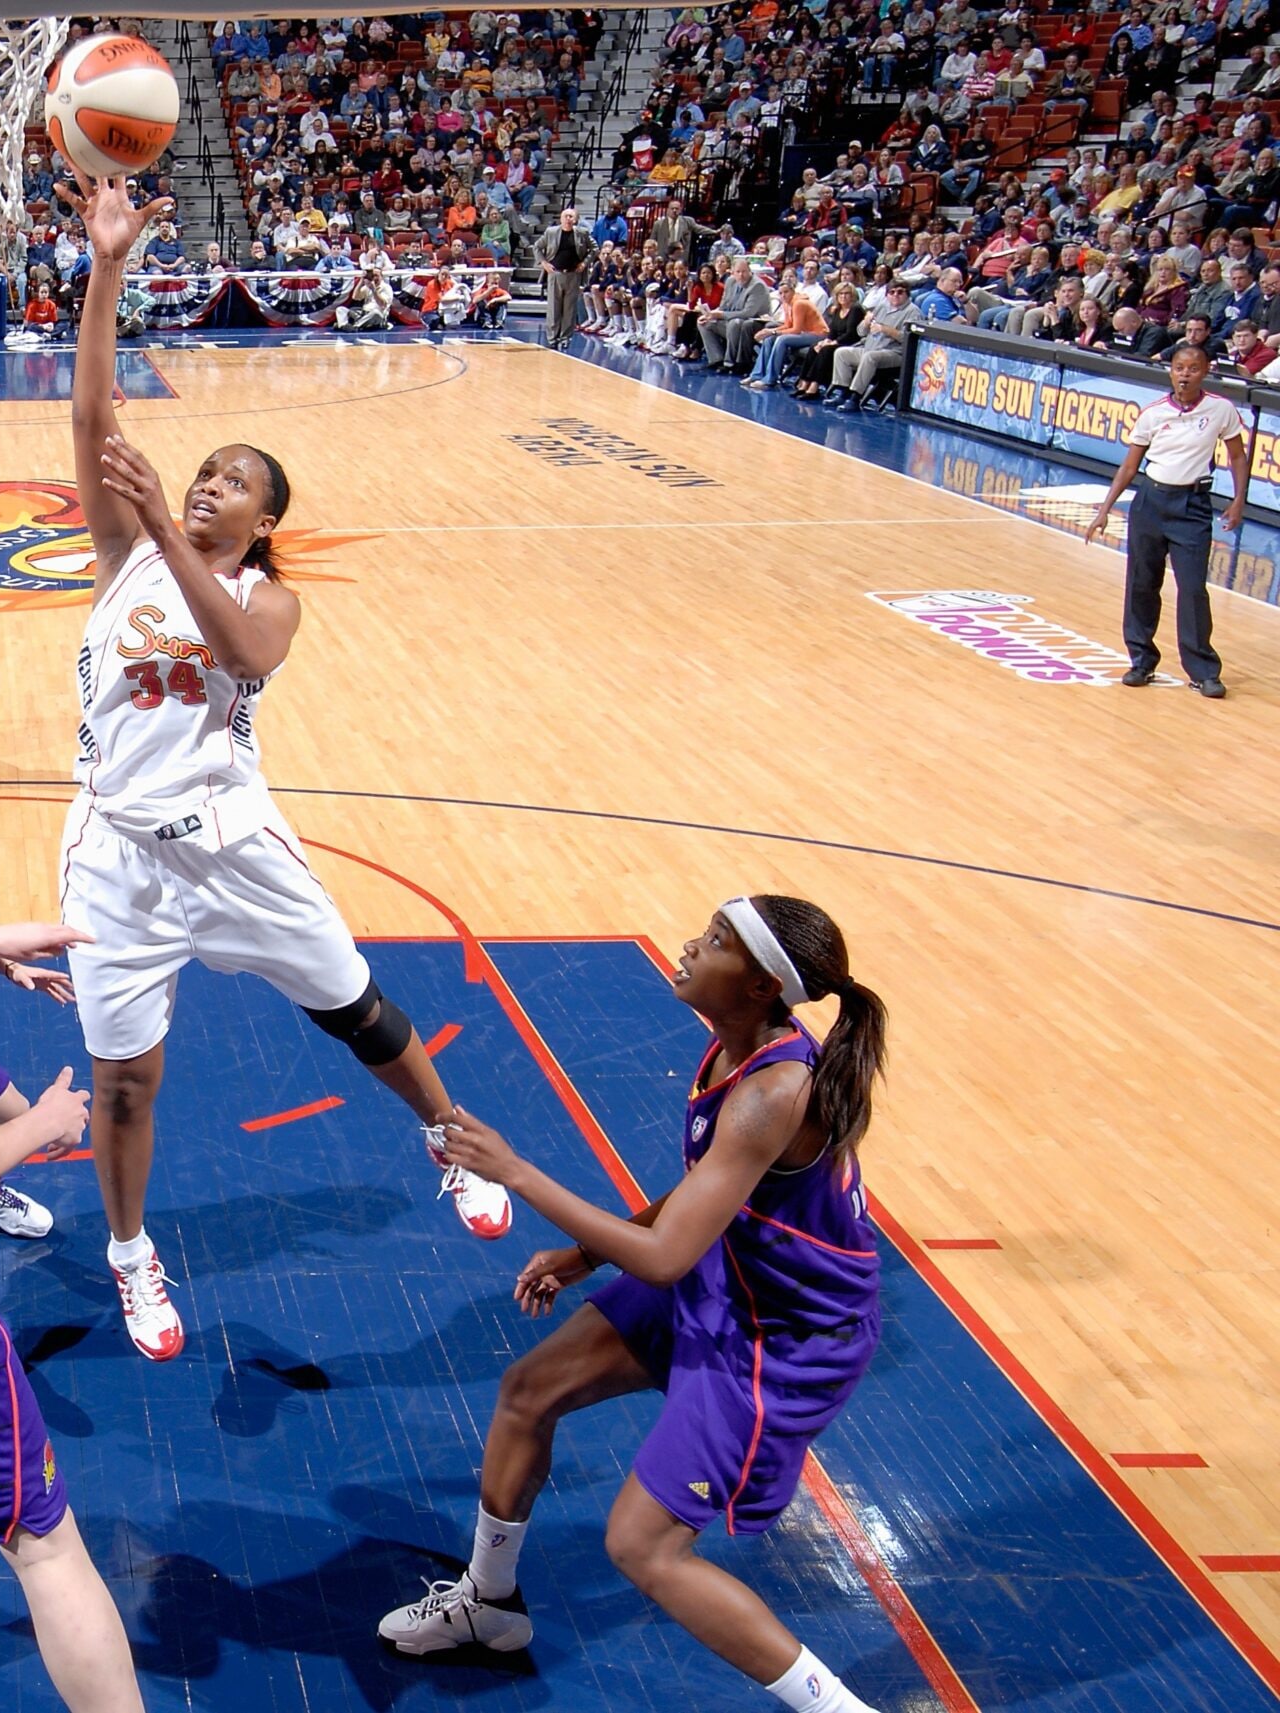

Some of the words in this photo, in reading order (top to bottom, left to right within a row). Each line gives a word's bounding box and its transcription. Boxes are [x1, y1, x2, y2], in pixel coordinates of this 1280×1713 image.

[950, 362, 991, 408] FOR
[993, 372, 1036, 420] SUN
[1040, 384, 1142, 447] TICKETS
[501, 434, 604, 467] ARENA
[531, 417, 668, 462] MOHEGAN
[629, 463, 725, 488] SUN
[116, 604, 218, 671] Sun
[915, 614, 1094, 681] DONUTS
[123, 660, 208, 711] 34
